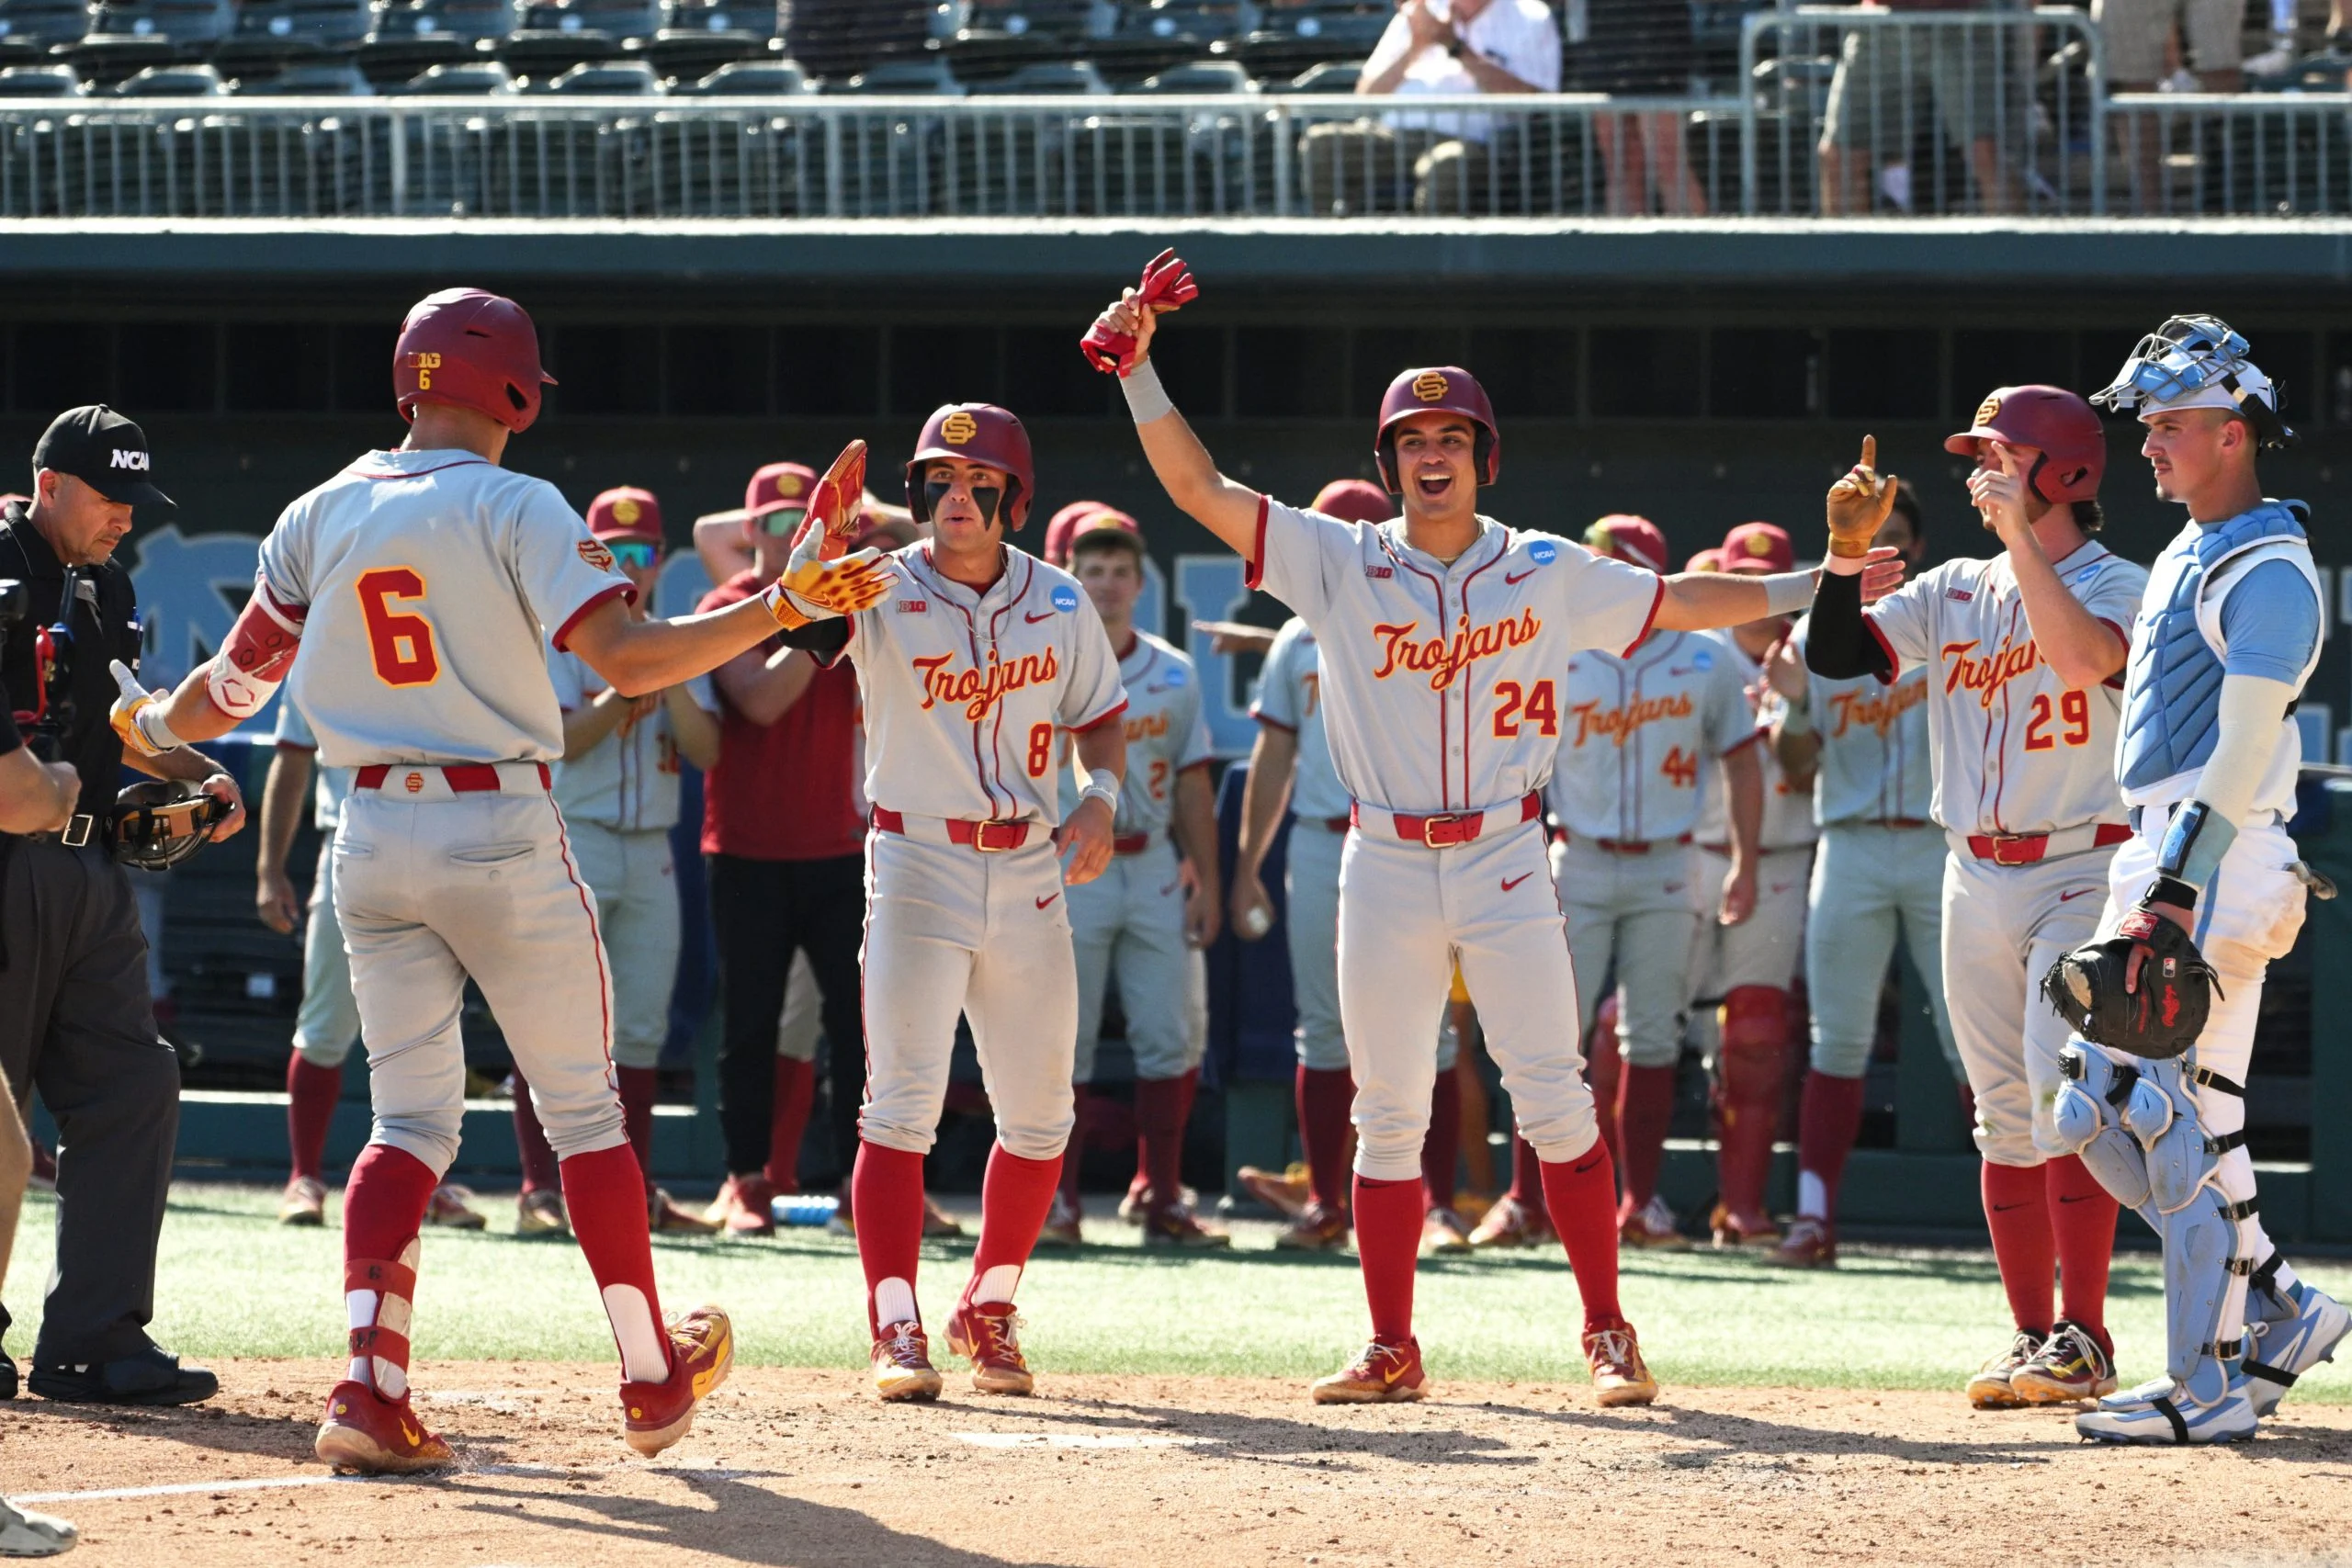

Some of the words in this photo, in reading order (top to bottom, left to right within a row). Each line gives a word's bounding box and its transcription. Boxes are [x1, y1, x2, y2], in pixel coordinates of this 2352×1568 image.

[419, 369, 431, 390] 6
[109, 448, 150, 471] NCA
[1532, 550, 1555, 560] NCAA
[355, 565, 441, 689] 6
[1055, 597, 1076, 607] NCAA
[1373, 606, 1542, 691] Trojans
[911, 645, 1058, 722] Trojans
[1493, 679, 1558, 739] 24
[1570, 691, 1693, 748] Trojans
[2024, 689, 2090, 752] 29
[1026, 720, 1054, 779] 8
[1660, 745, 1698, 789] 44
